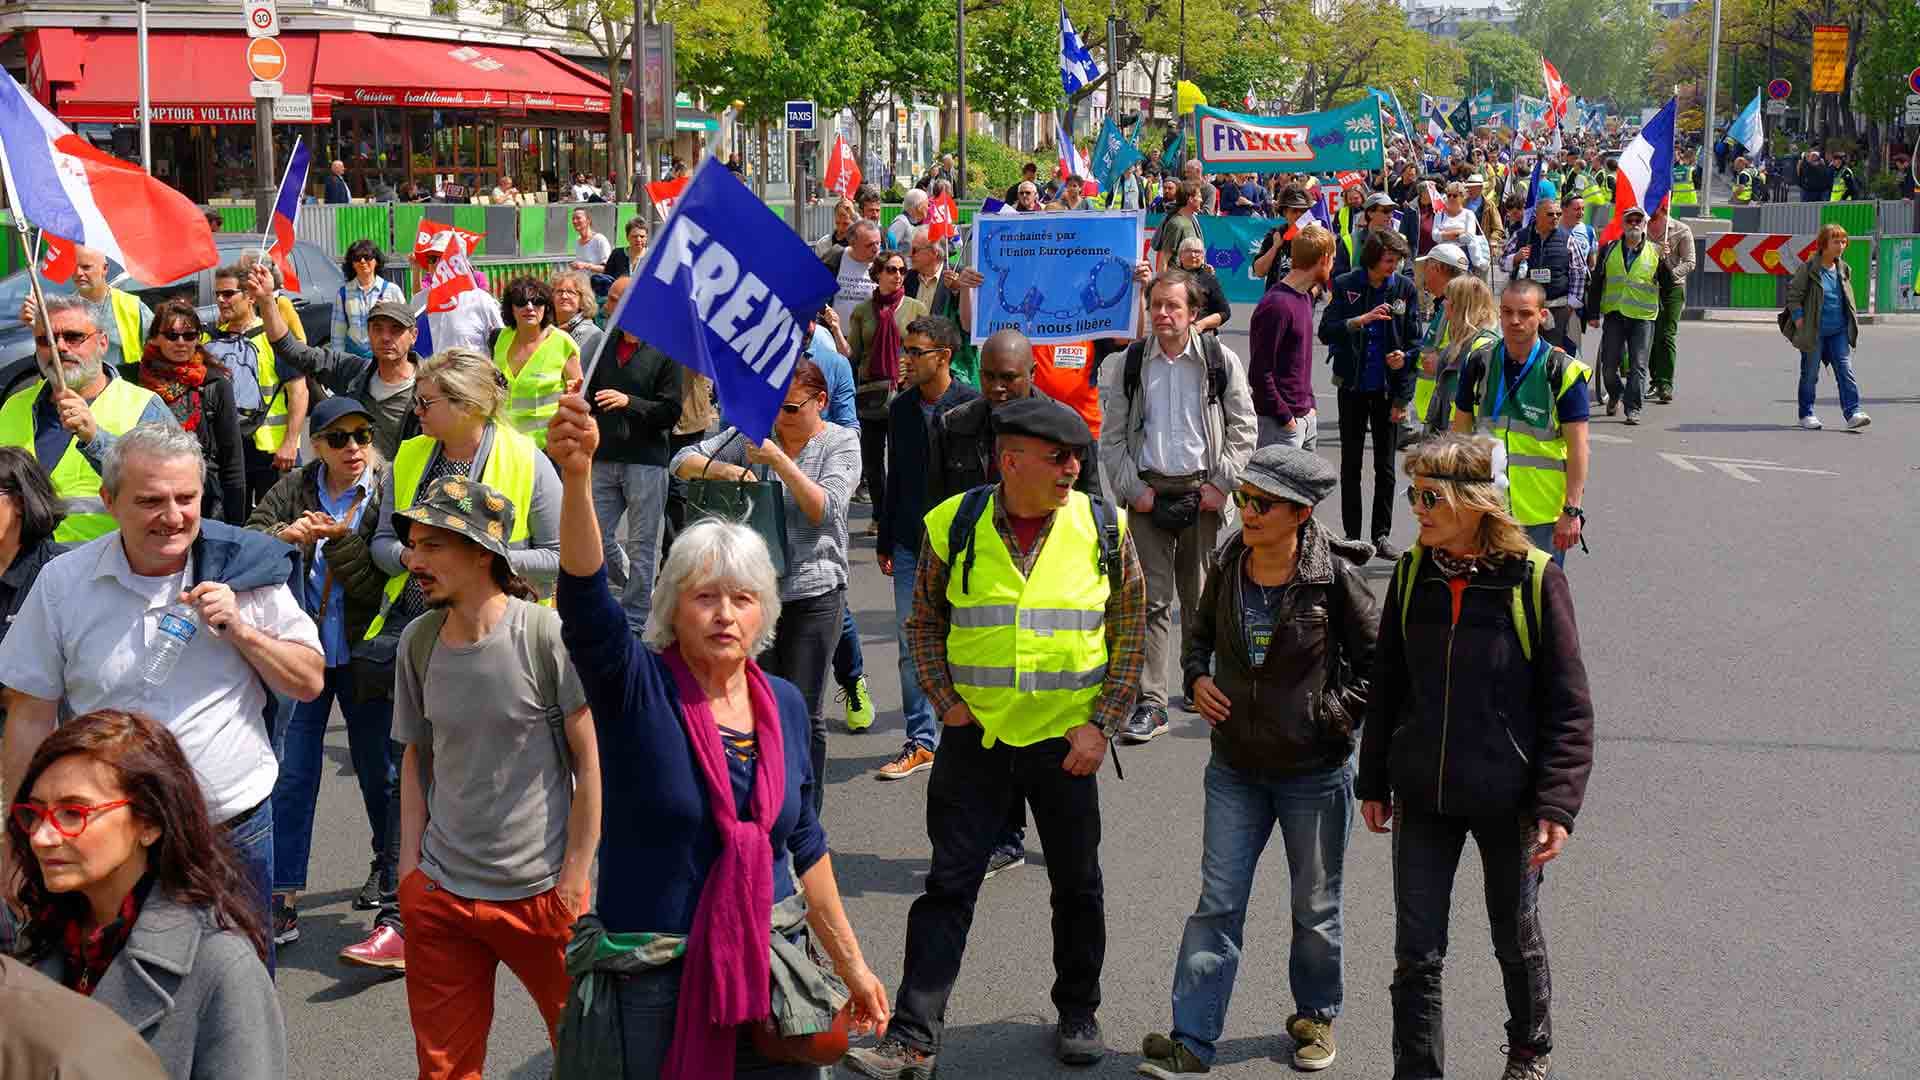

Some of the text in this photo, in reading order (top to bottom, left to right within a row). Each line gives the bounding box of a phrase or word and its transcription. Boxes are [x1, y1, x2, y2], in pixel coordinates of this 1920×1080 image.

[256, 14, 269, 23] 30
[355, 87, 394, 102] Cuisine
[133, 107, 194, 121] CMPTOIR
[274, 105, 310, 113] VOLTAIRE
[788, 111, 812, 121] TAXIS
[1213, 124, 1299, 152] FREXIT
[1349, 137, 1378, 154] upr
[1056, 231, 1077, 242] par
[1039, 246, 1112, 258] Européenne
[654, 214, 805, 390] FREXIT
[1037, 323, 1072, 334] nous
[1076, 317, 1112, 333] libère
[1058, 347, 1083, 355] FREXIT
